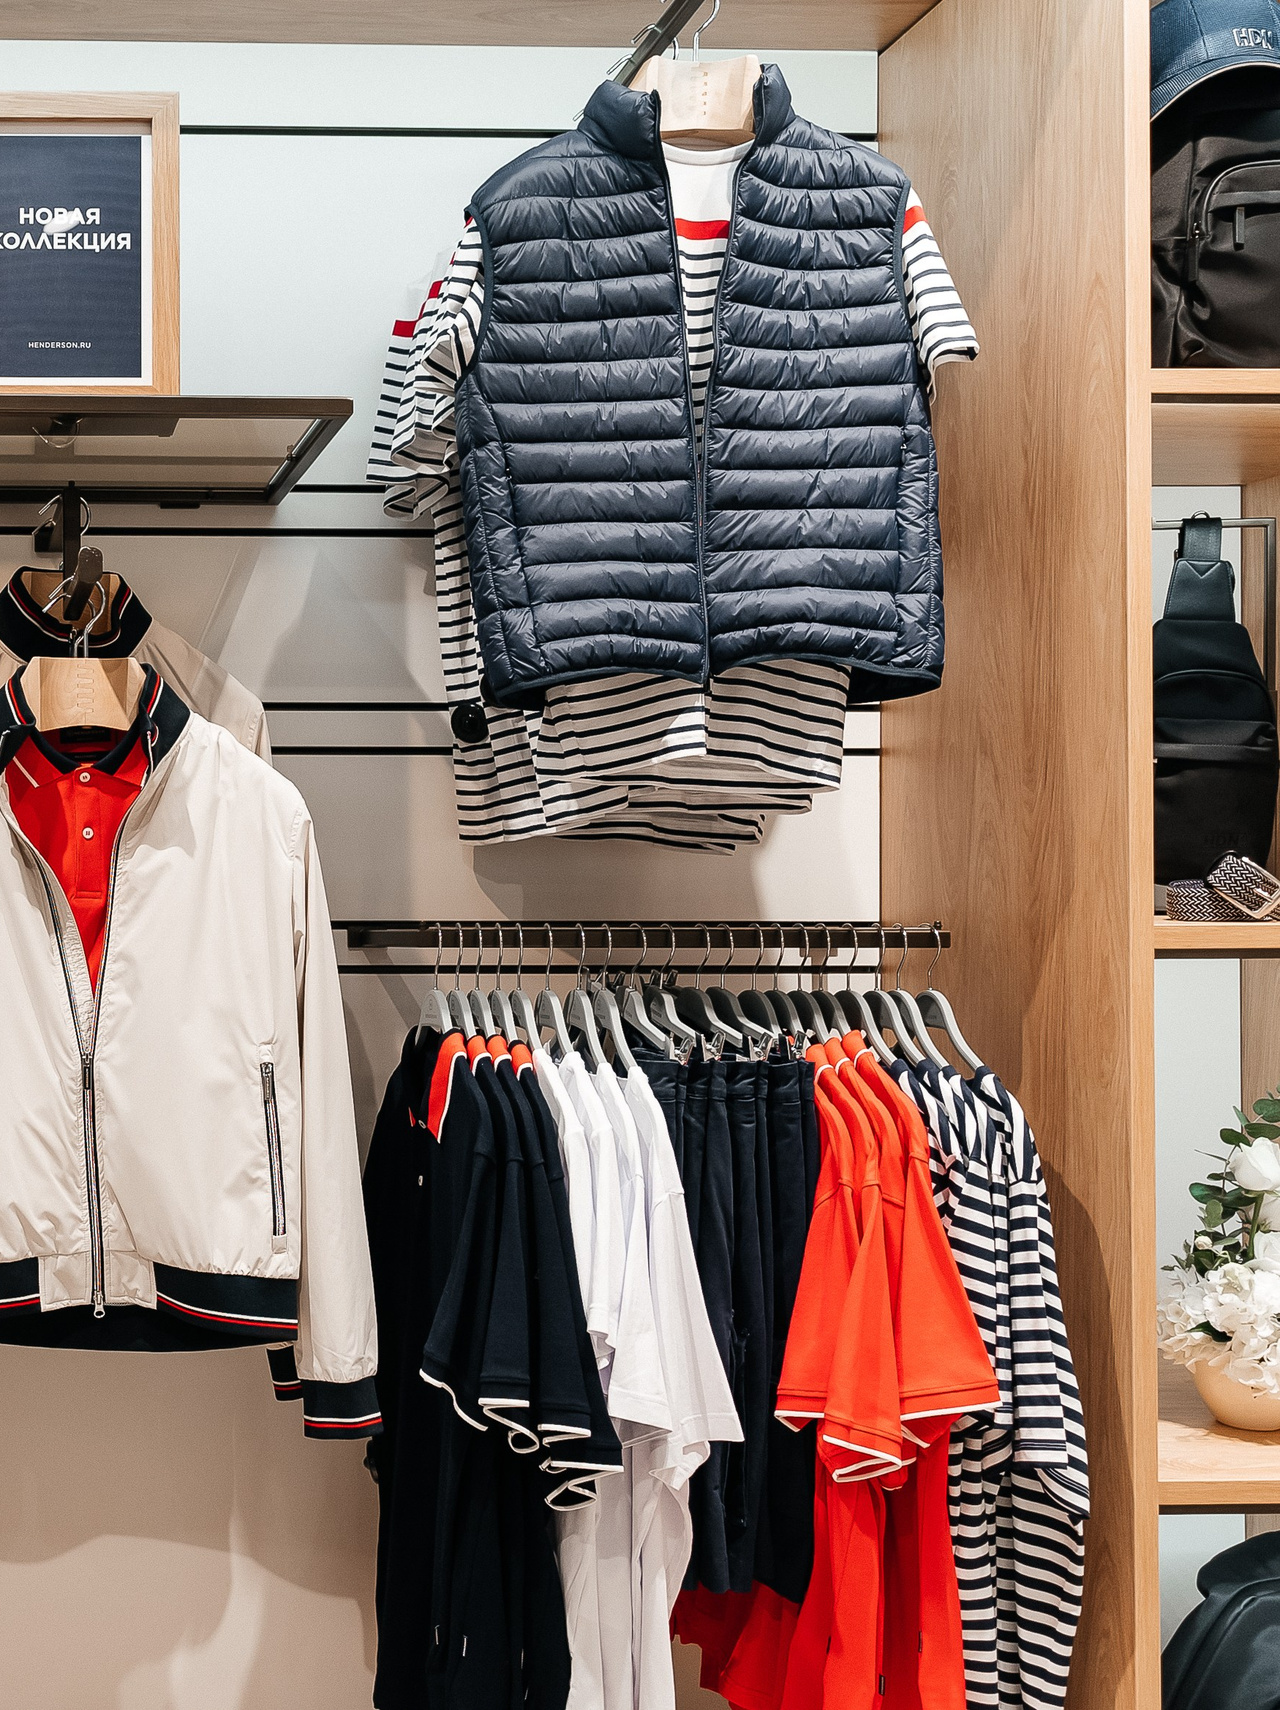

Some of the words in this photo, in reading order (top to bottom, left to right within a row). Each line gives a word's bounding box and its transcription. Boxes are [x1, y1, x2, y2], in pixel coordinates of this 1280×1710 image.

[1232, 28, 1273, 49] HDN
[19, 207, 100, 225] НОВАЯ
[28, 341, 92, 349] HENDERSON.RU
